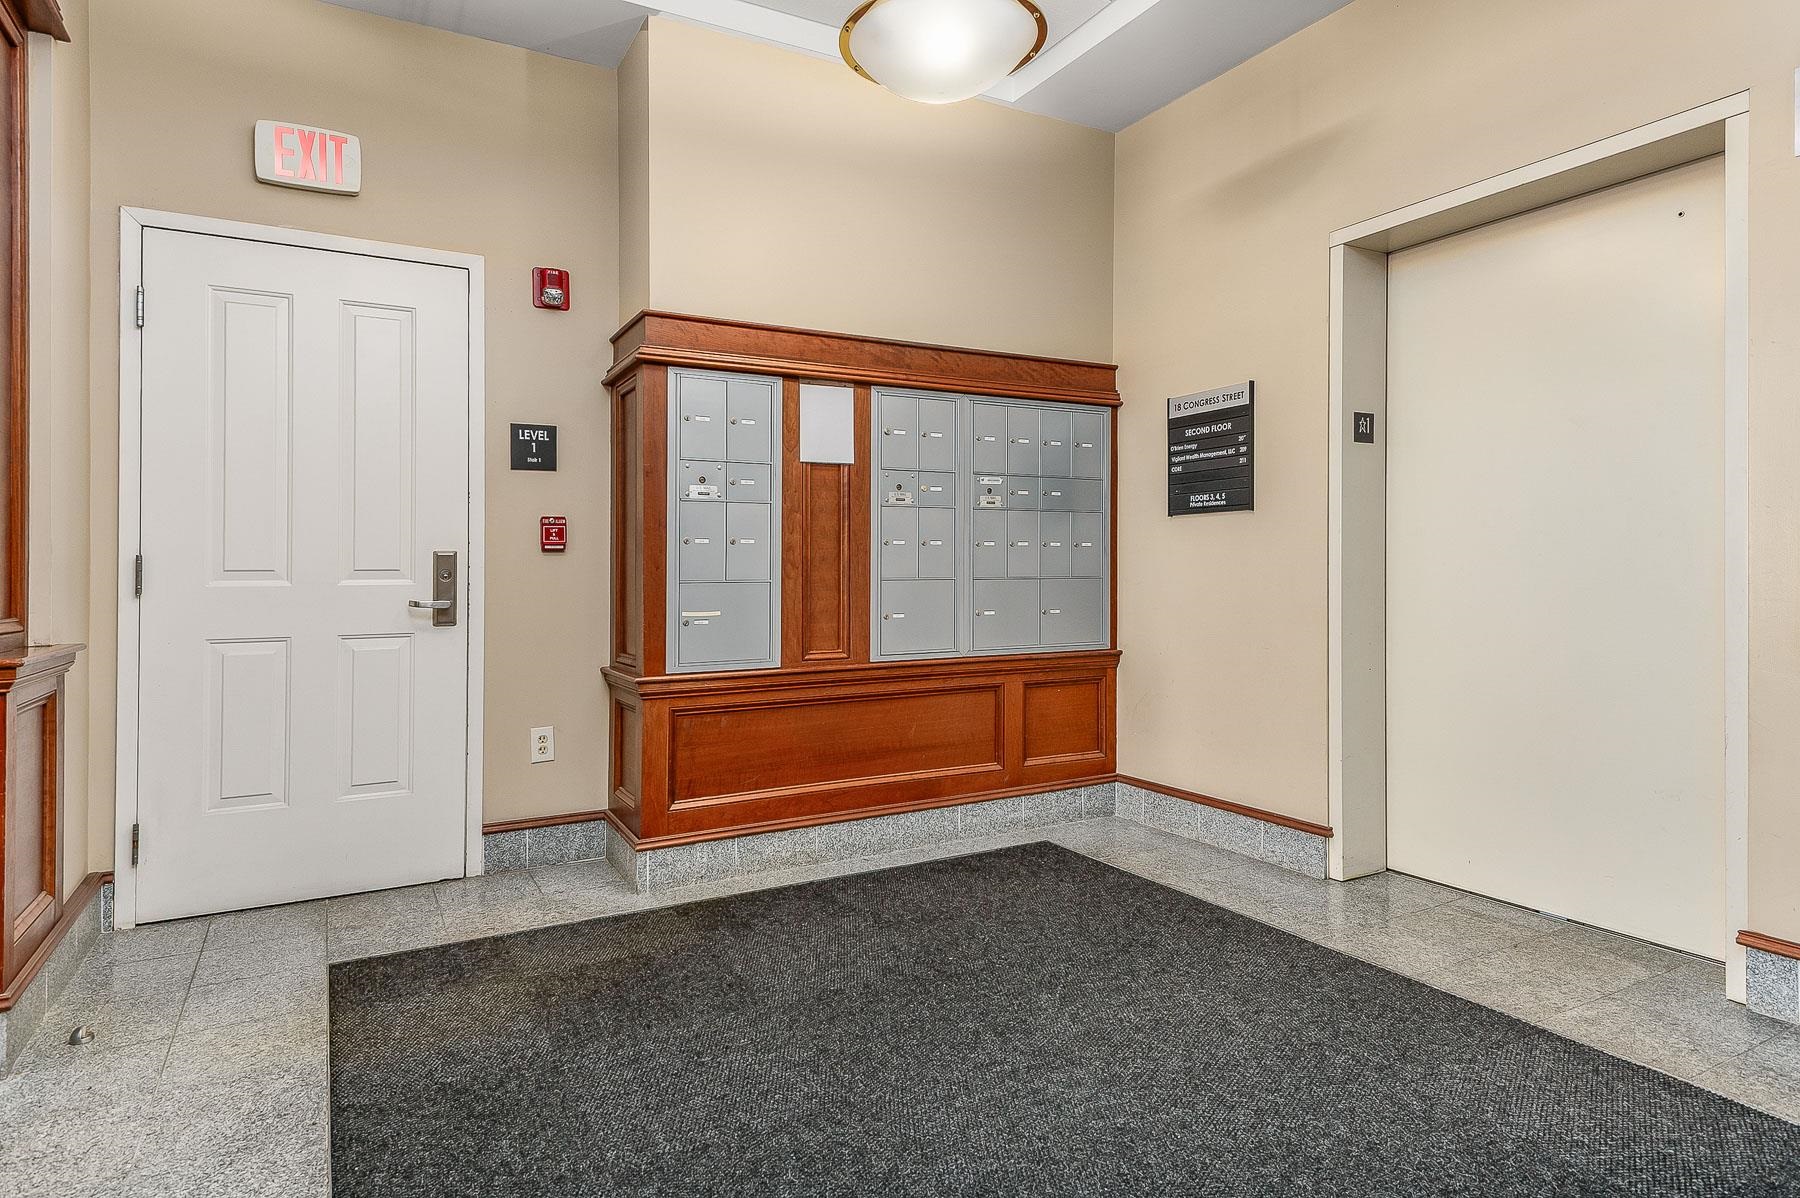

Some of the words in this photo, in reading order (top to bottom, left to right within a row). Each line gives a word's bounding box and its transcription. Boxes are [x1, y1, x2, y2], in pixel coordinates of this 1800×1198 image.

[274, 126, 348, 184] EXIT
[1174, 403, 1182, 412] 18
[1183, 396, 1220, 410] CONGRESS
[1222, 391, 1245, 402] STREET
[519, 429, 550, 441] LEVEL
[1185, 426, 1211, 437] SECOND
[1211, 422, 1232, 433] FLOOR
[531, 442, 536, 453] 1
[1190, 494, 1210, 502] FLOORS
